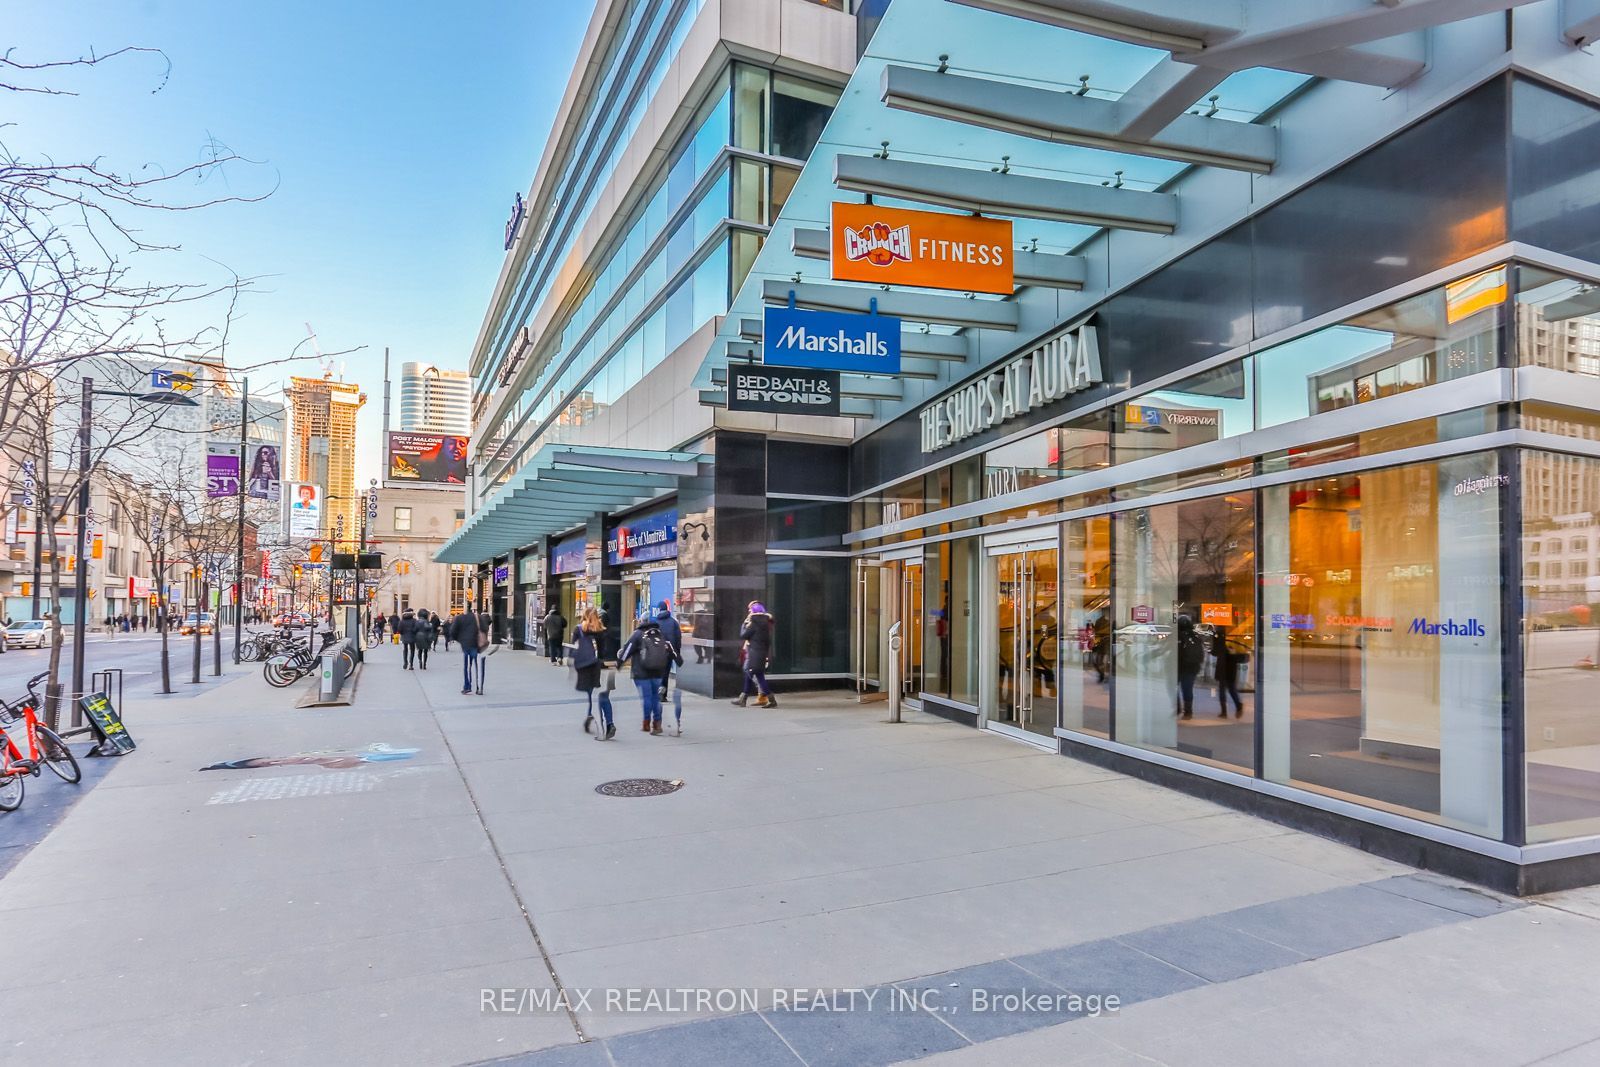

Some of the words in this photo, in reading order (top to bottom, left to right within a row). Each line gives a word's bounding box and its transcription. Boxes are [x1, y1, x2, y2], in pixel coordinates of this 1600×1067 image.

[845, 225, 912, 260] CRUNCH
[919, 238, 1003, 266] FITNESS
[775, 325, 888, 357] Marshalls
[736, 374, 770, 389] BED
[771, 377, 815, 393] BATH
[816, 379, 832, 393] &
[919, 402, 945, 453] THE
[945, 374, 998, 442] SHOPS
[1001, 357, 1030, 418] AT
[1029, 325, 1103, 407] AURA
[736, 389, 832, 405] BEYOND
[626, 534, 639, 549] Bank
[639, 532, 644, 546] of
[644, 525, 667, 546] Montreal
[1407, 617, 1486, 637] Marshalls
